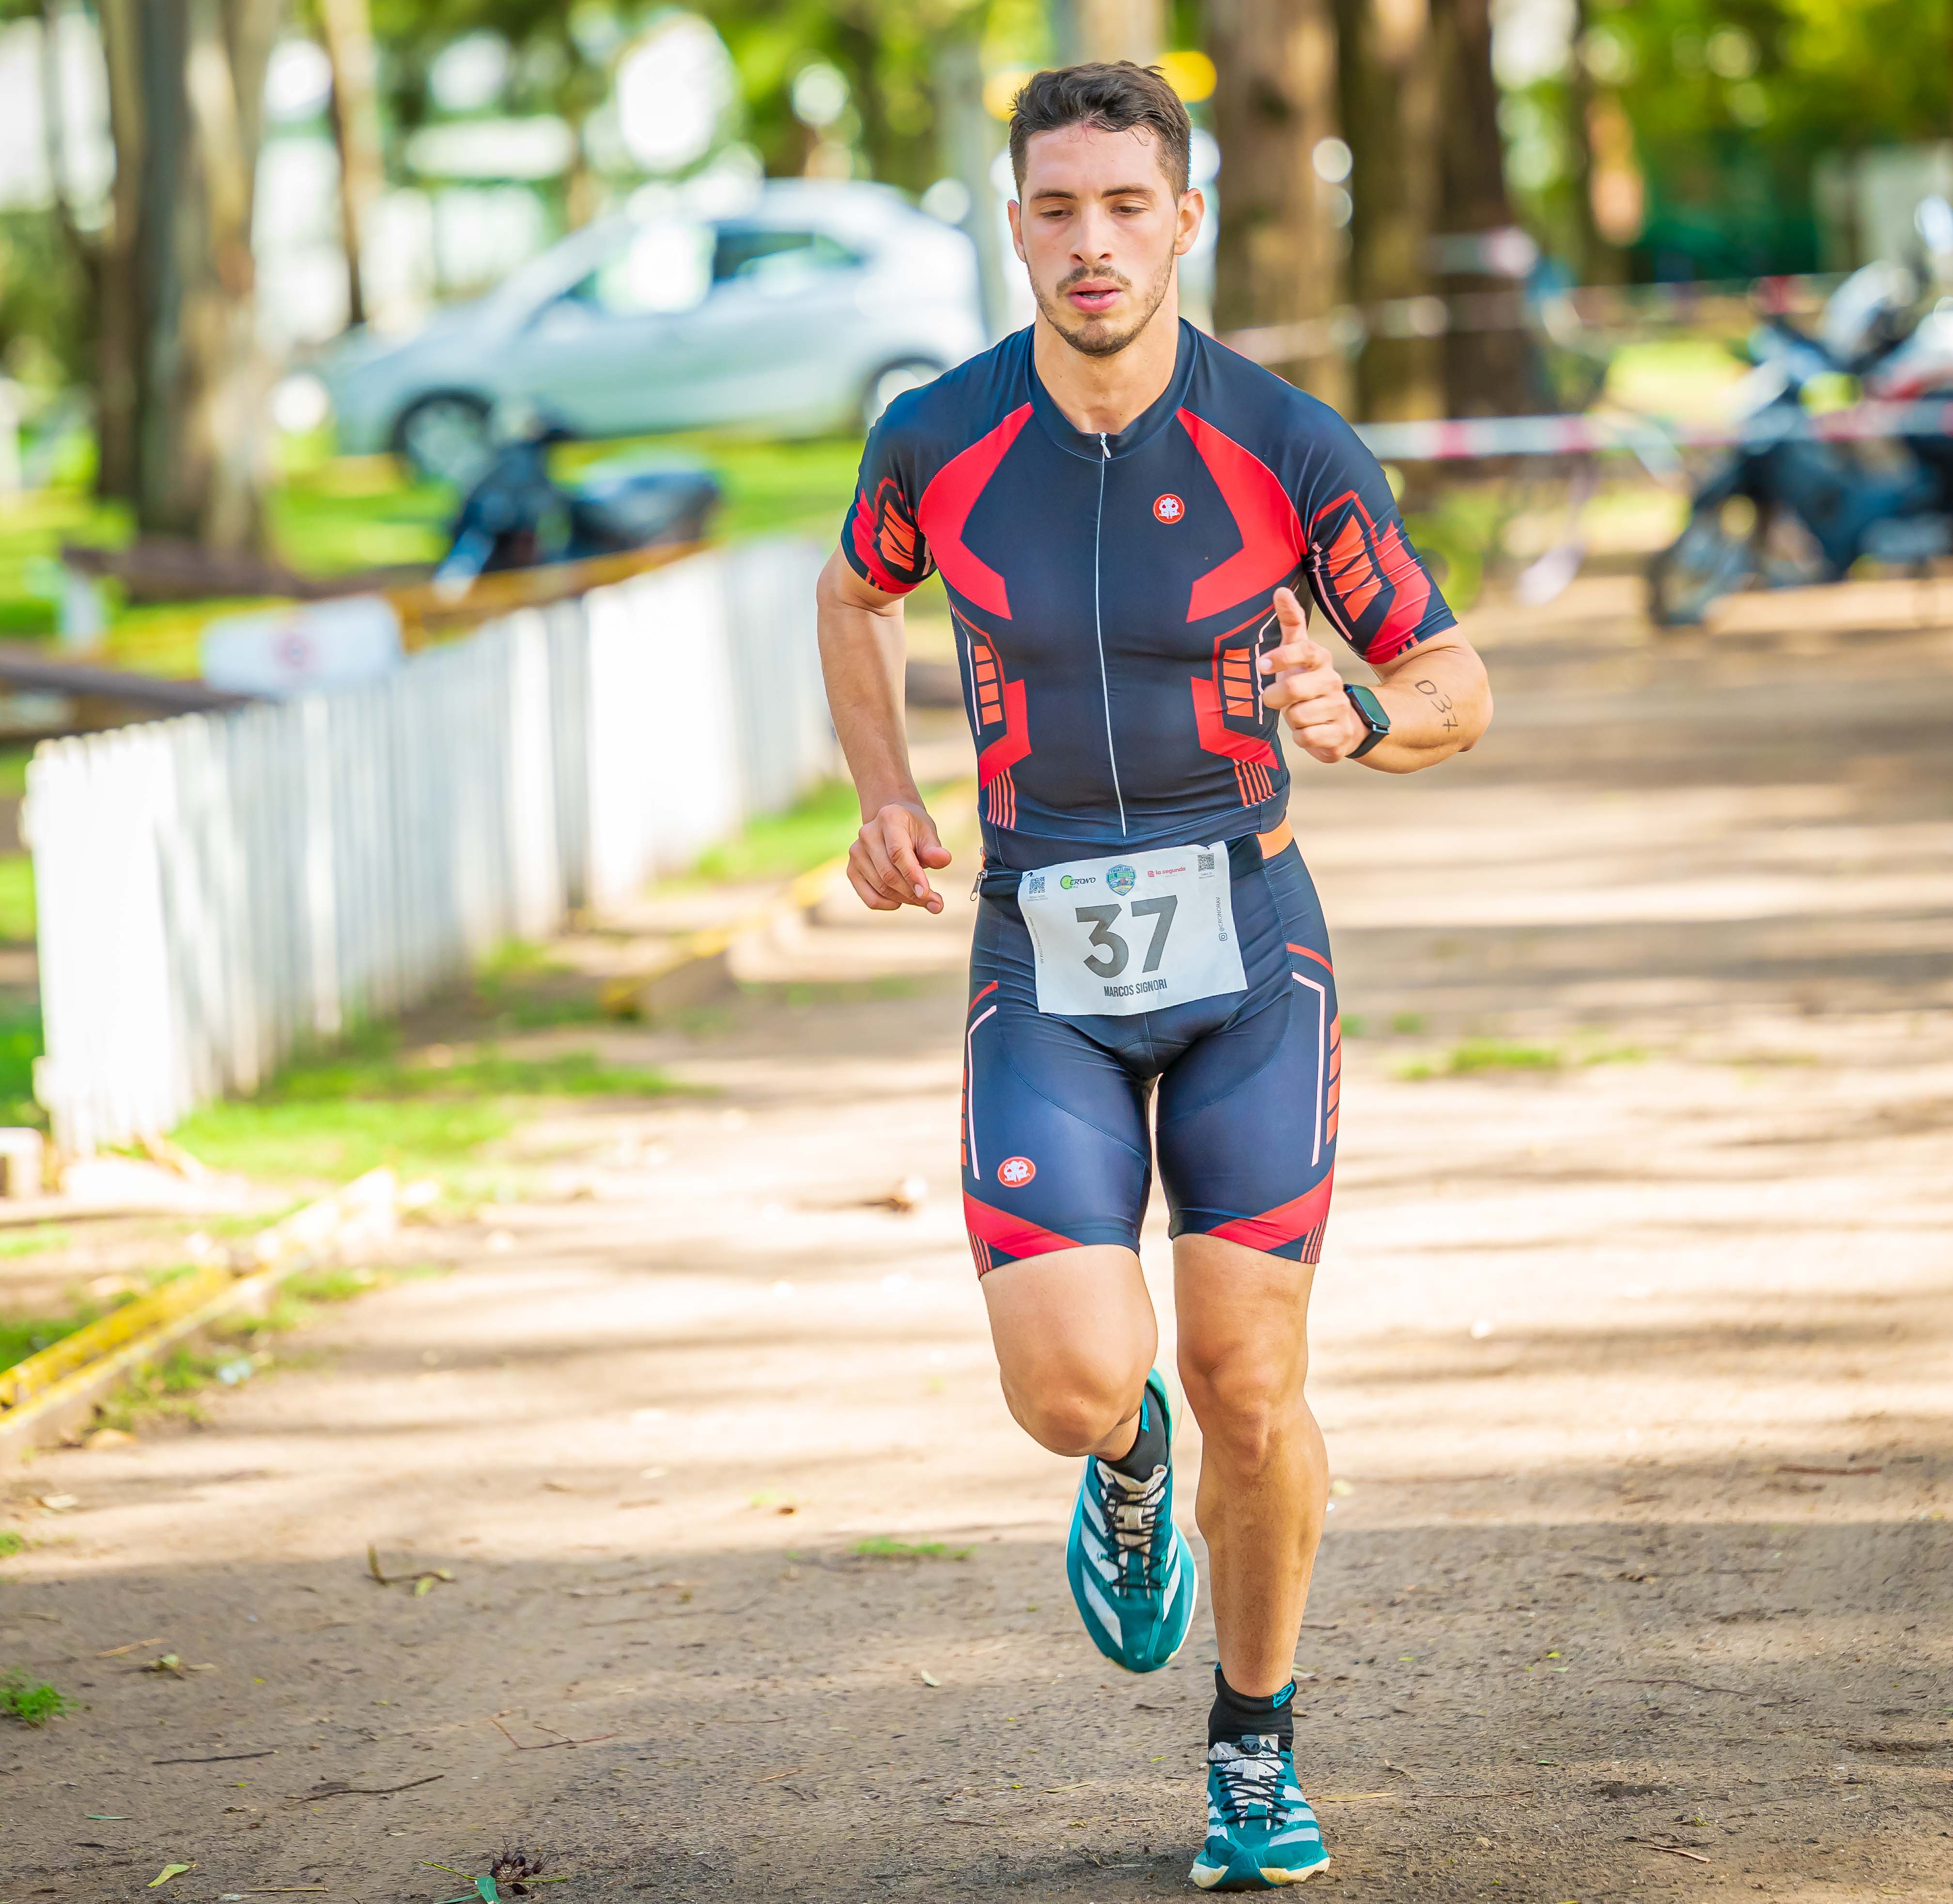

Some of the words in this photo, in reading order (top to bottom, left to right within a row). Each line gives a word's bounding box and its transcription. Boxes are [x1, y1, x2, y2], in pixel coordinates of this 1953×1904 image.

[1415, 680, 1458, 732] 037
[1215, 897, 1224, 932] @CRONORAV
[1075, 895, 1178, 978] 37
[1103, 985, 1134, 997] MARCOS
[1135, 978, 1167, 994] SIGNORI
